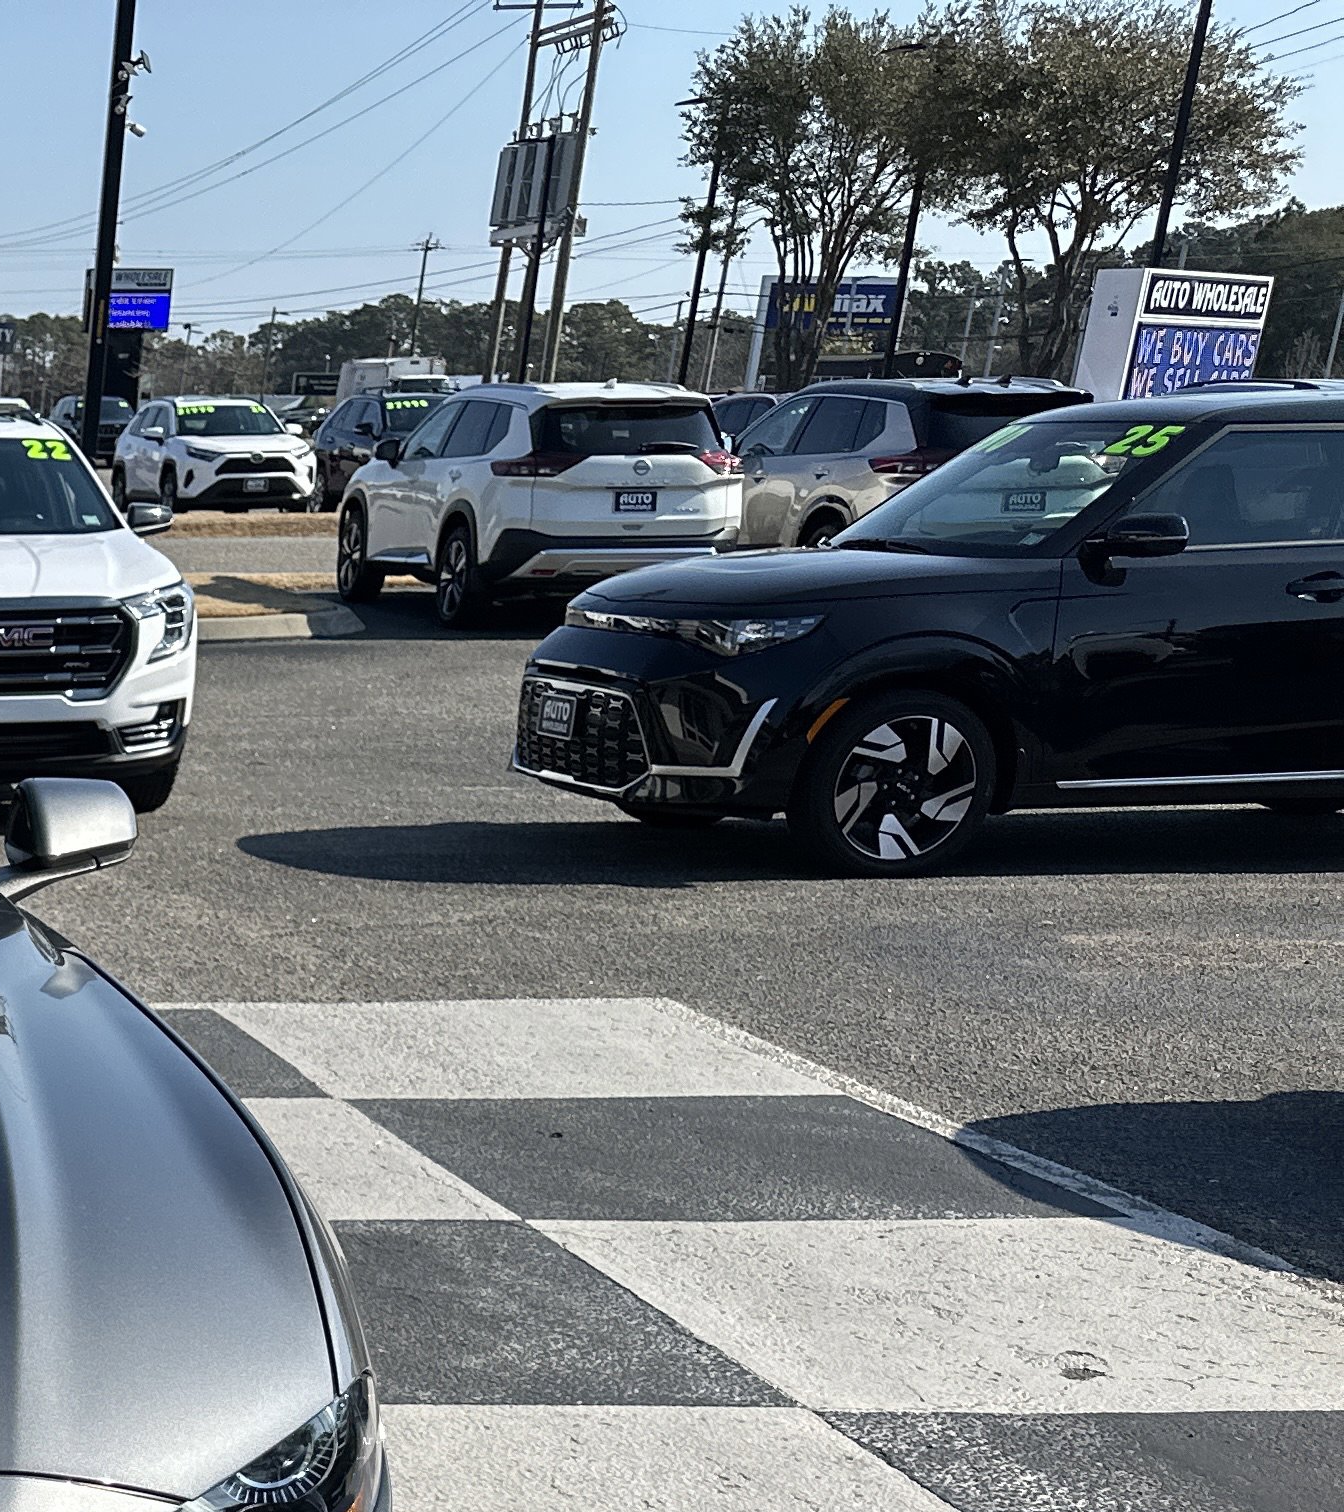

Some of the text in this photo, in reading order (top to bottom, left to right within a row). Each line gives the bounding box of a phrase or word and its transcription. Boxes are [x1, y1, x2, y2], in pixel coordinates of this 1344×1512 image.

[1149, 280, 1268, 316] AUTO WHOLESALE
[1137, 328, 1259, 368] WE BUY CARS
[1128, 366, 1158, 400] WE
[21, 437, 73, 461] 22
[1103, 424, 1186, 458] 25
[619, 493, 653, 505] AUTO
[543, 699, 571, 721] AUTO
